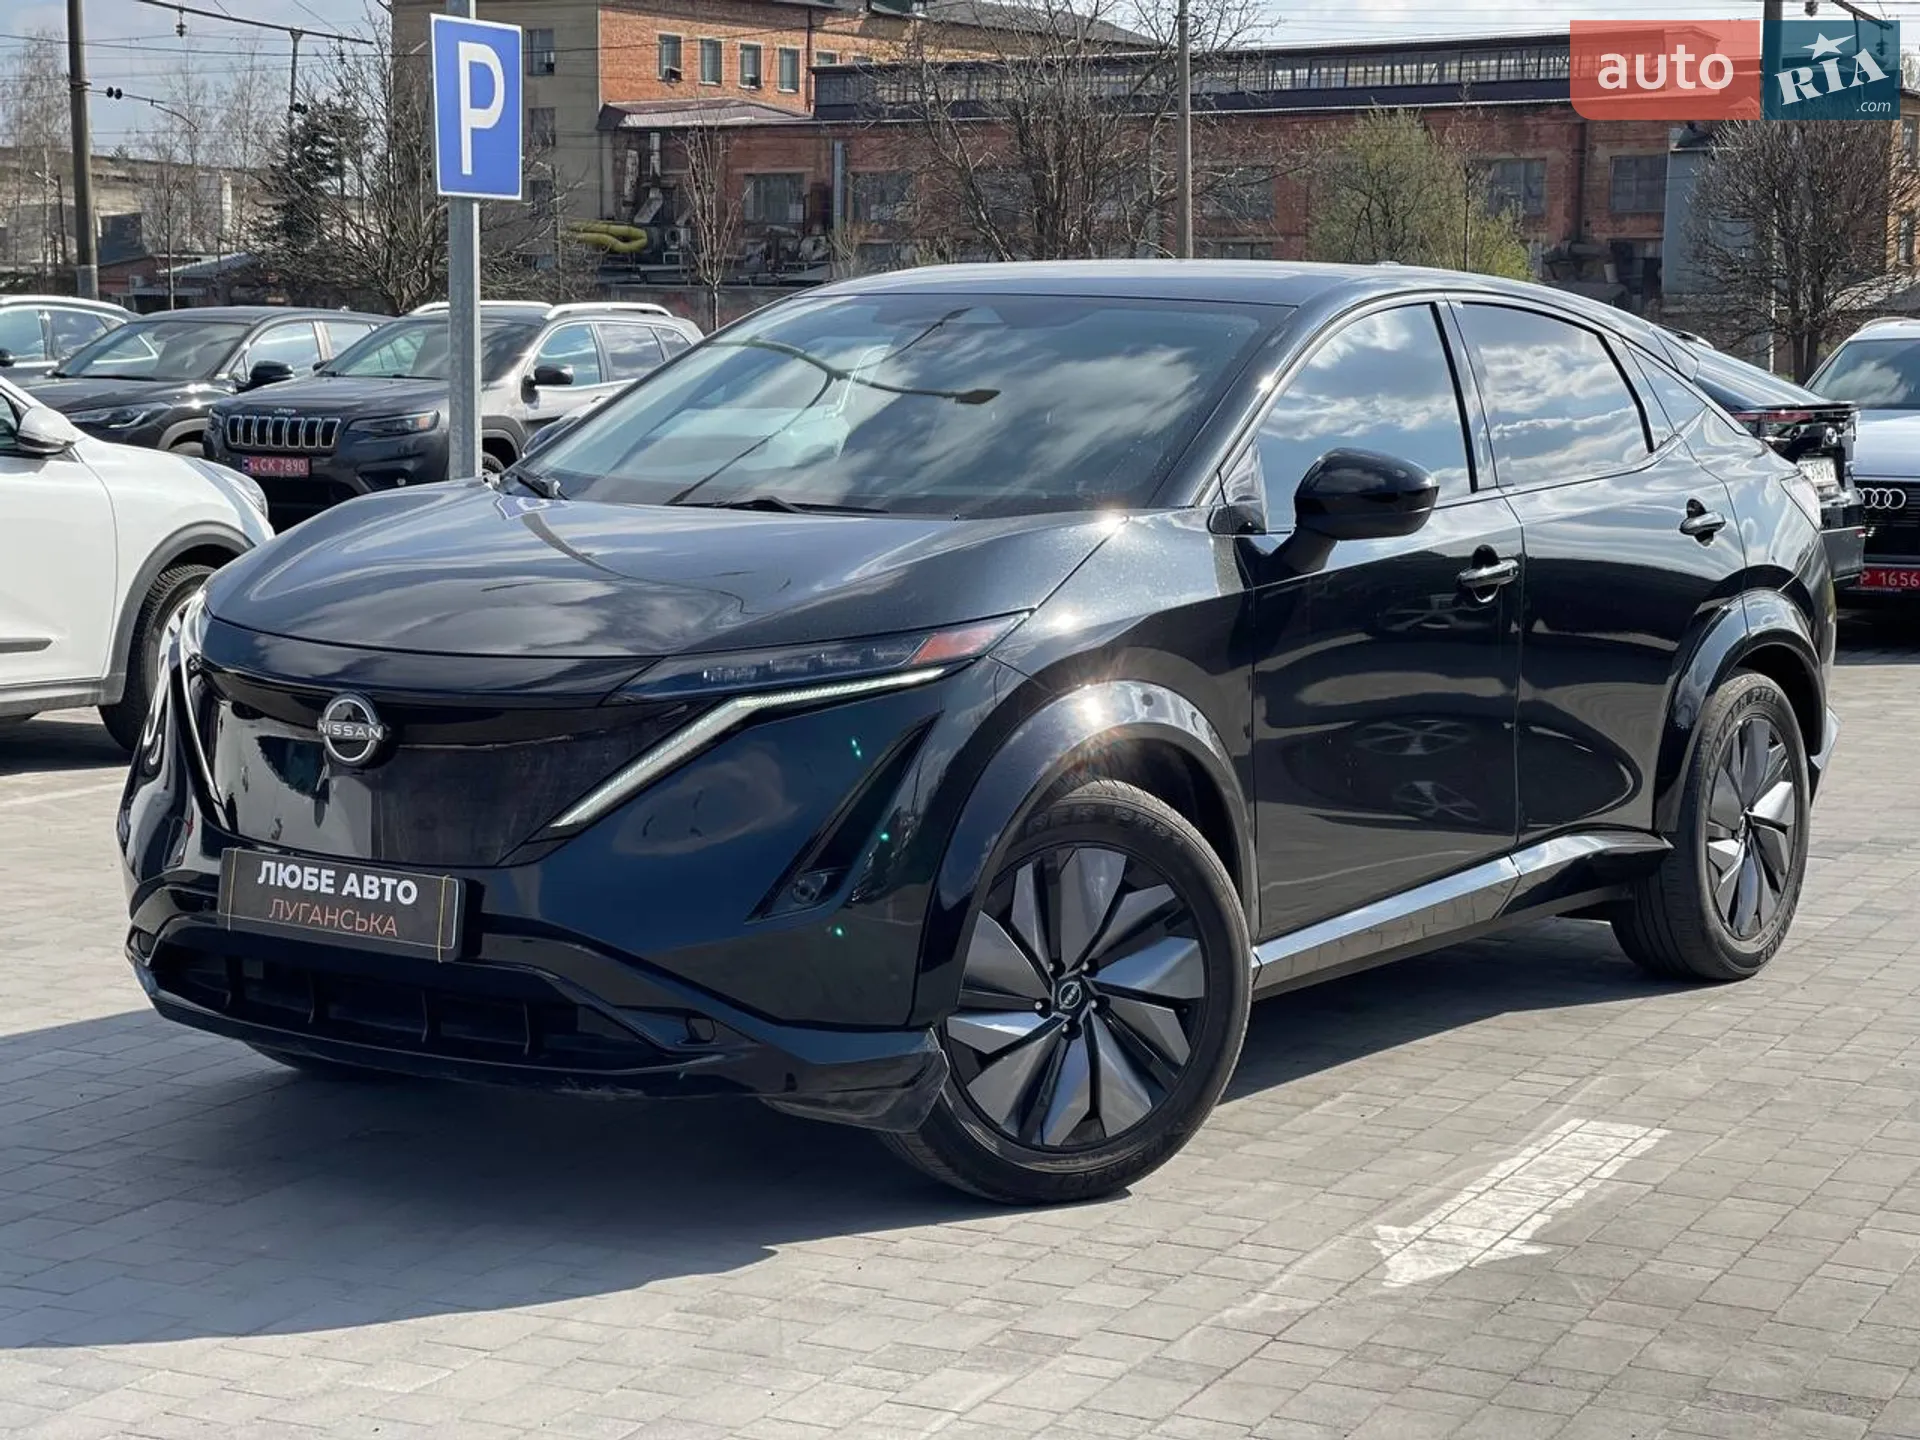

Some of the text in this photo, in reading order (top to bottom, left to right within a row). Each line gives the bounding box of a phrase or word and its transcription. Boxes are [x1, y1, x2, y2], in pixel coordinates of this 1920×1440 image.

[458, 41, 505, 175] P
[1878, 571, 1920, 587] 1656
[317, 721, 383, 740] NISSAN
[257, 860, 418, 905] ЛЮБЕ АВТО
[269, 898, 398, 937] ЛУГАНСЬКА
